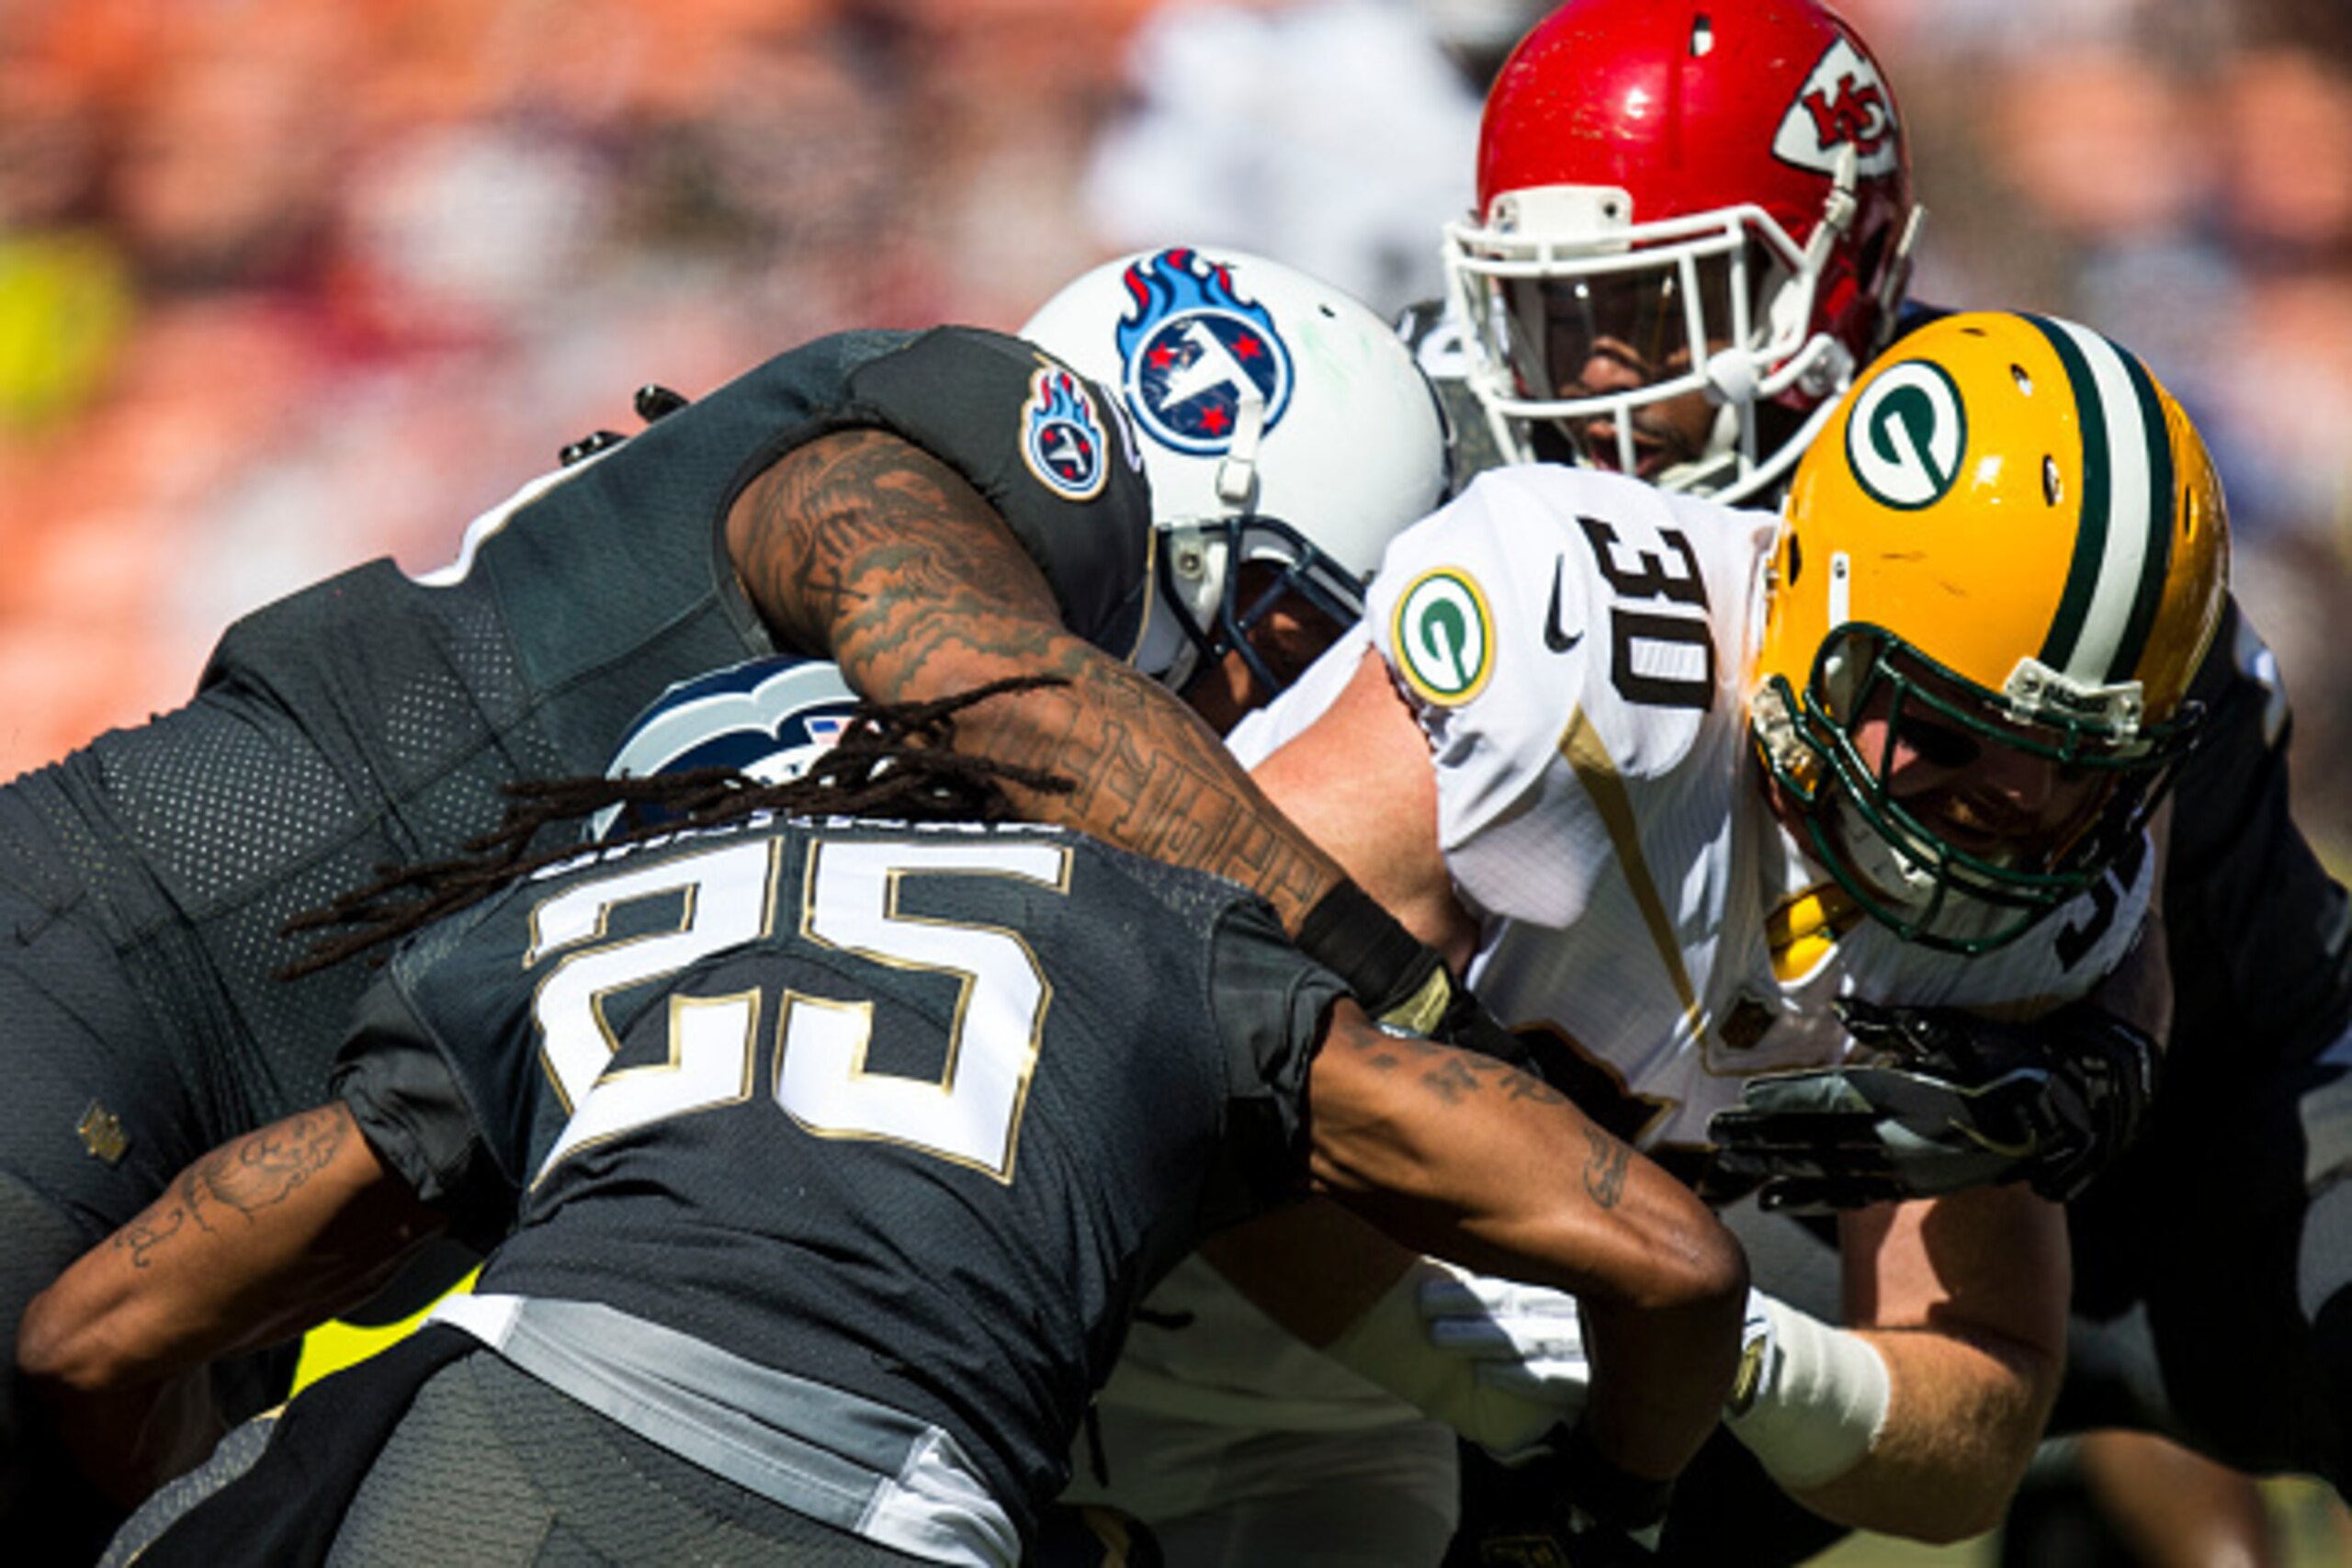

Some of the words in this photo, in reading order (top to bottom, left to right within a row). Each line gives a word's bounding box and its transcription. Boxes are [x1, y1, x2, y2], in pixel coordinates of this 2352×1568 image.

[1802, 72, 1885, 158] KC
[1850, 362, 1961, 503] G
[1404, 576, 1483, 691] G
[1576, 515, 1716, 713] 30
[523, 835, 1074, 1191] 25
